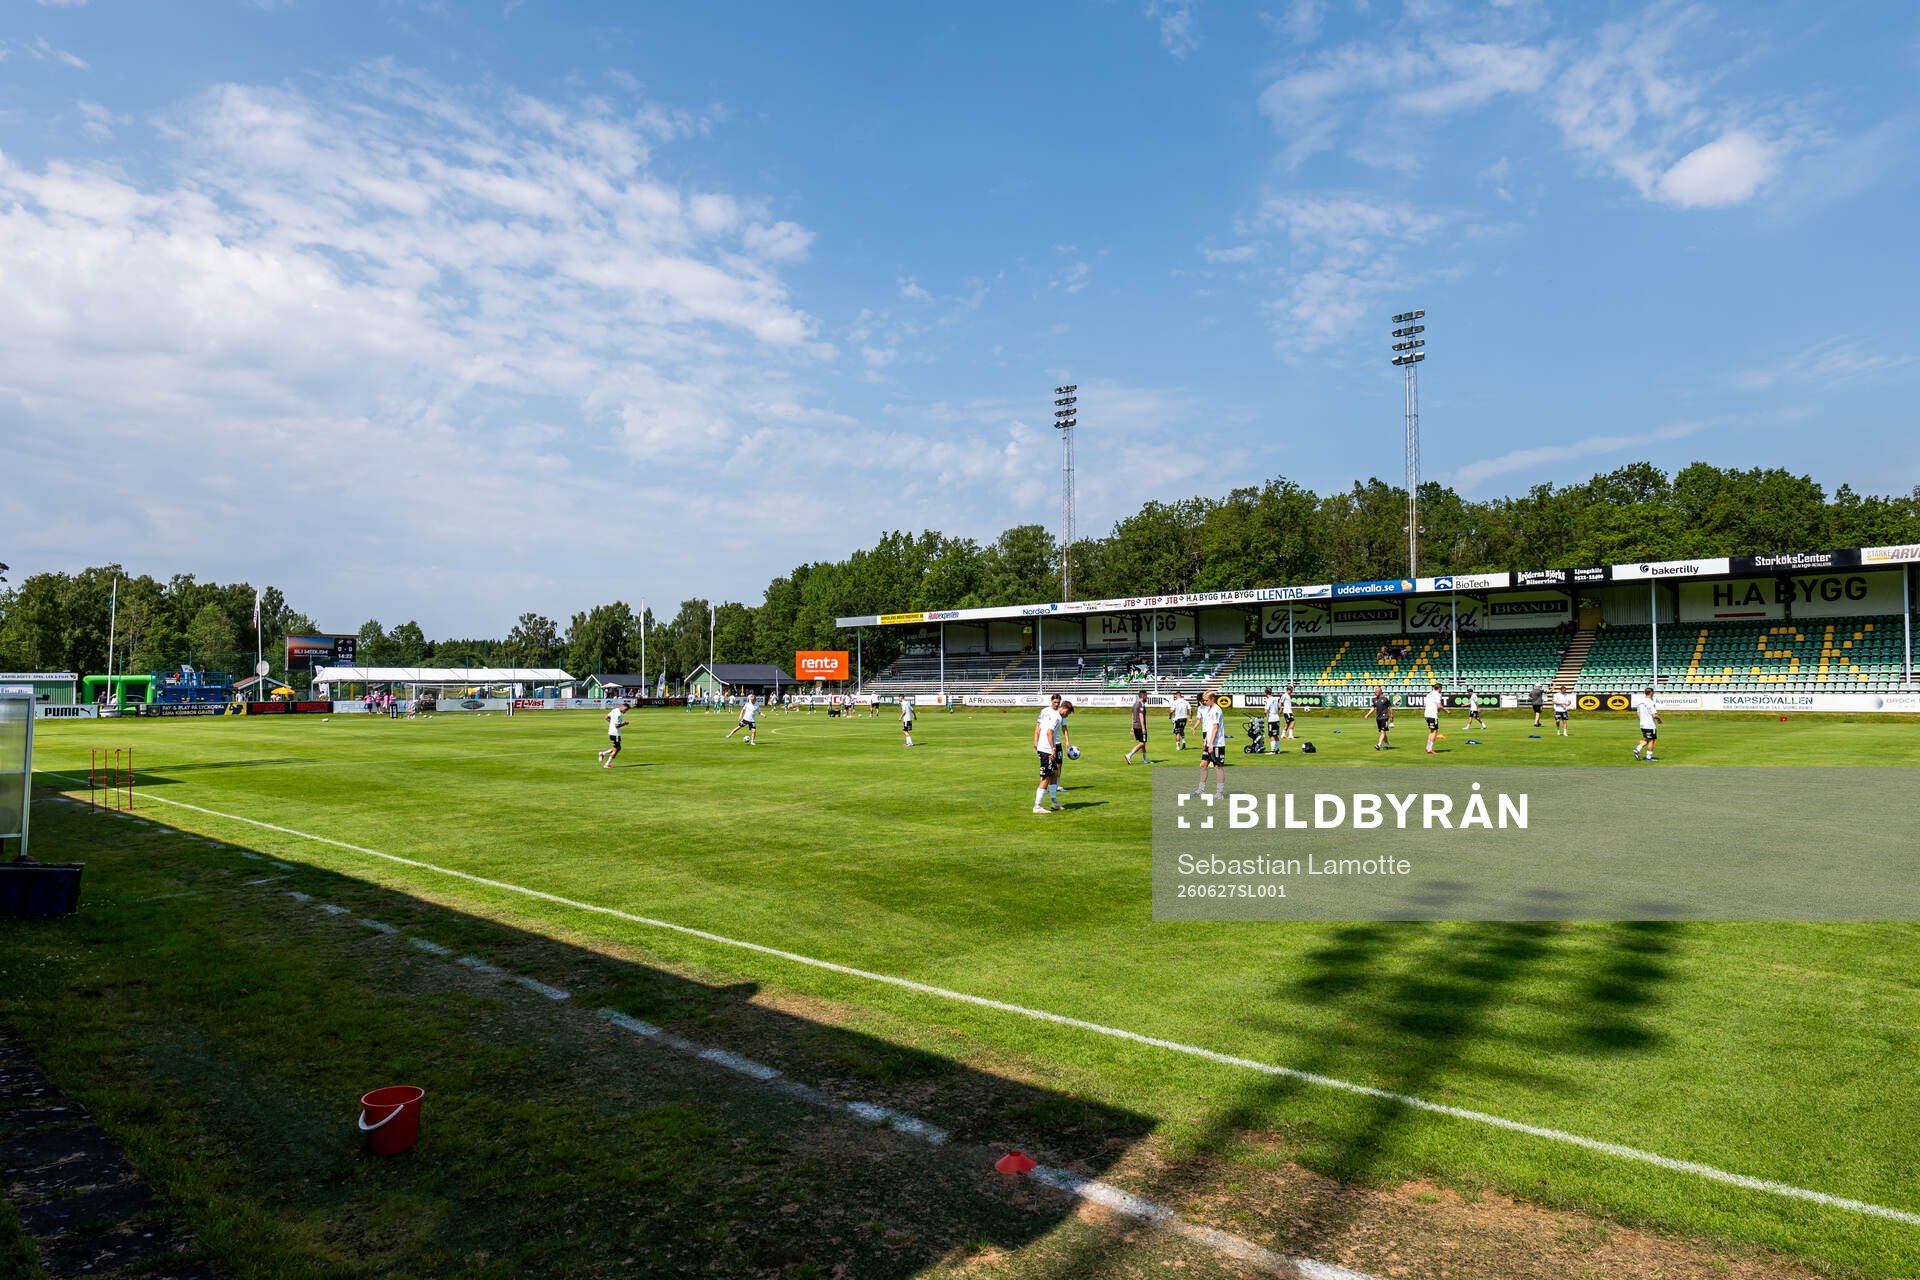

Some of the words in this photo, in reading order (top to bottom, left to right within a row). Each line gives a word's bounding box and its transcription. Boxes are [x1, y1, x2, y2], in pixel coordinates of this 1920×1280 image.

[1891, 547, 1920, 560] ARV
[1755, 553, 1832, 566] StorköksCenter
[1651, 564, 1700, 575] bakertilly
[1337, 584, 1395, 595] uddevalla.se
[1455, 580, 1490, 589] BioTech
[1234, 590, 1255, 599] BYGG
[1256, 588, 1303, 601] LLENTAB
[1713, 582, 1766, 607] H.A
[1774, 576, 1868, 604] BYGG
[1144, 597, 1157, 606] JTB
[1165, 596, 1178, 605] JTB
[1199, 593, 1219, 601] BYGG
[1123, 599, 1136, 607] JTB
[1022, 607, 1051, 615] Nordea
[1337, 611, 1395, 621] BRANDT
[1409, 601, 1479, 629] Ford
[1102, 617, 1128, 634] H.A
[1131, 614, 1177, 633] BYGG
[1266, 608, 1323, 635] Ford
[801, 656, 839, 669] renta
[1146, 697, 1163, 705] UMA
[44, 707, 80, 717] PUMA
